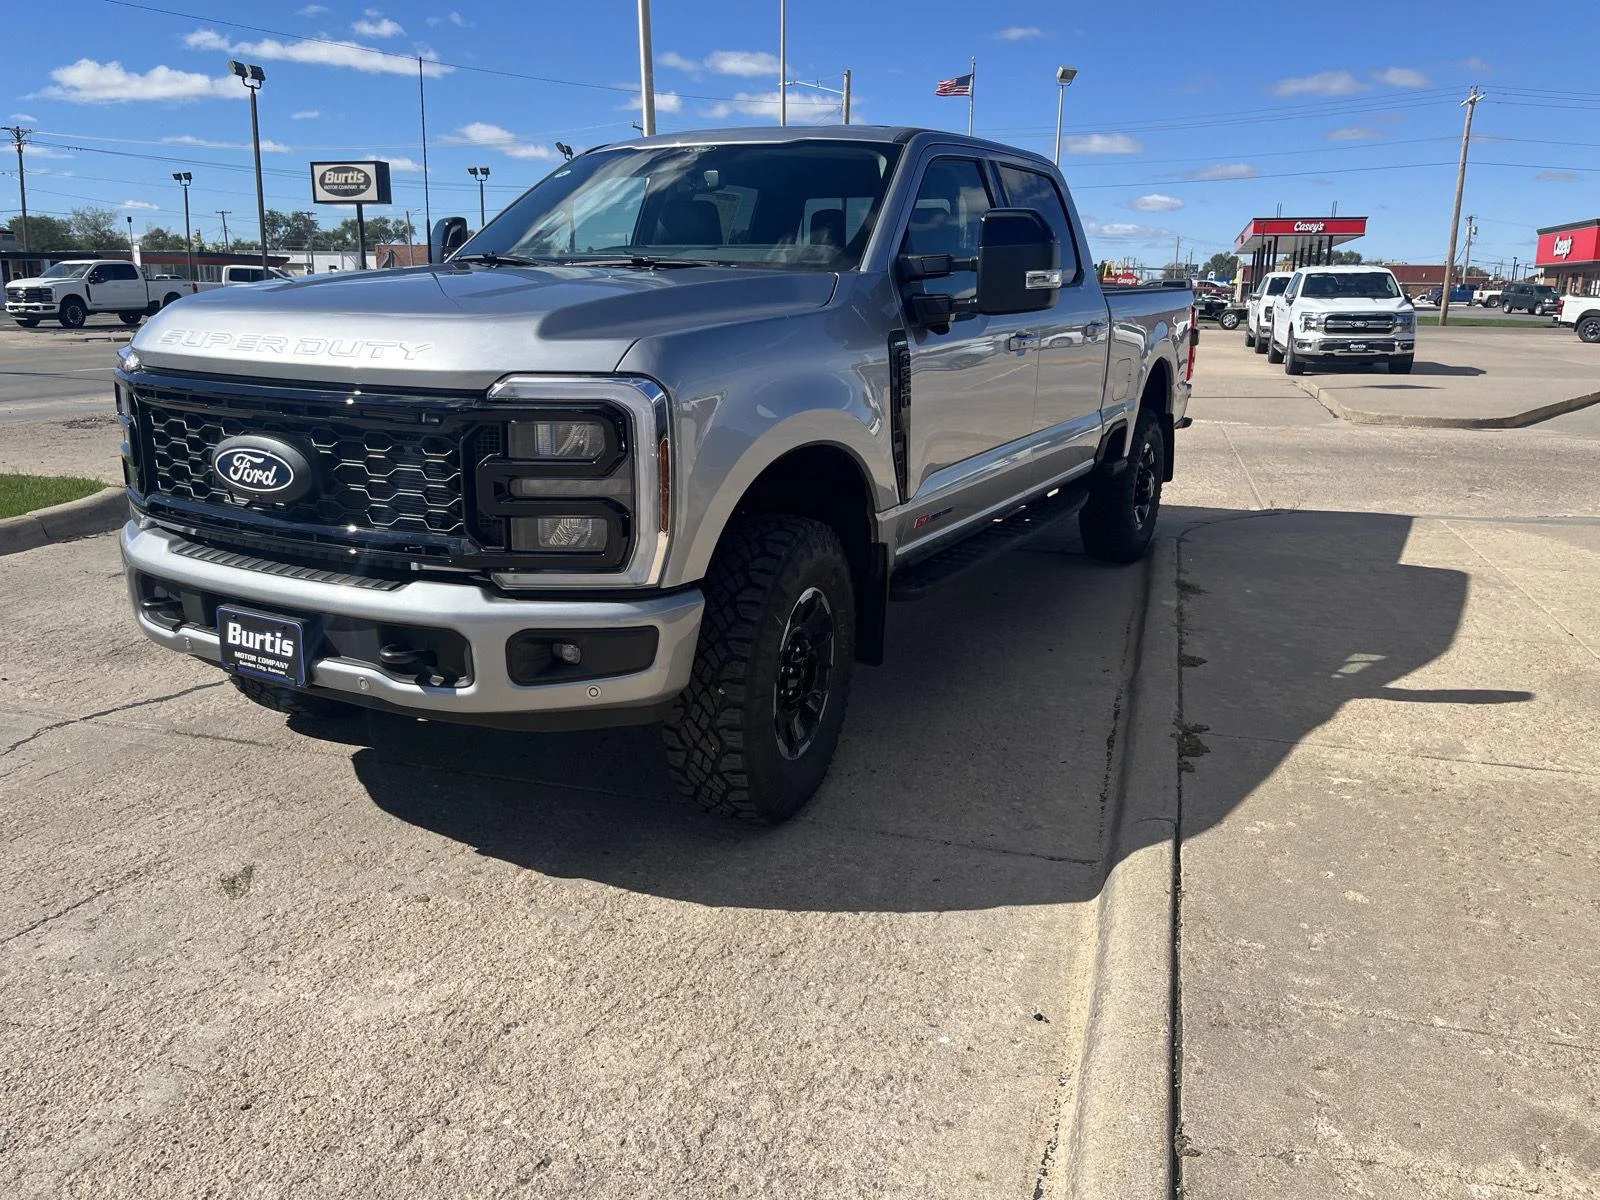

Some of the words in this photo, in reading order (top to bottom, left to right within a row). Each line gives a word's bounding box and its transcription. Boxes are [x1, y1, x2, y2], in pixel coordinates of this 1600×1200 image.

[325, 171, 365, 183] Burtis
[1293, 221, 1325, 233] Casey's
[1117, 277, 1137, 285] Casey's
[159, 328, 288, 353] SUPER
[293, 337, 433, 360] DUTY
[229, 453, 277, 486] Ford
[228, 622, 293, 657] Burtis
[234, 651, 257, 662] MOTOR
[258, 656, 289, 670] COMPANY
